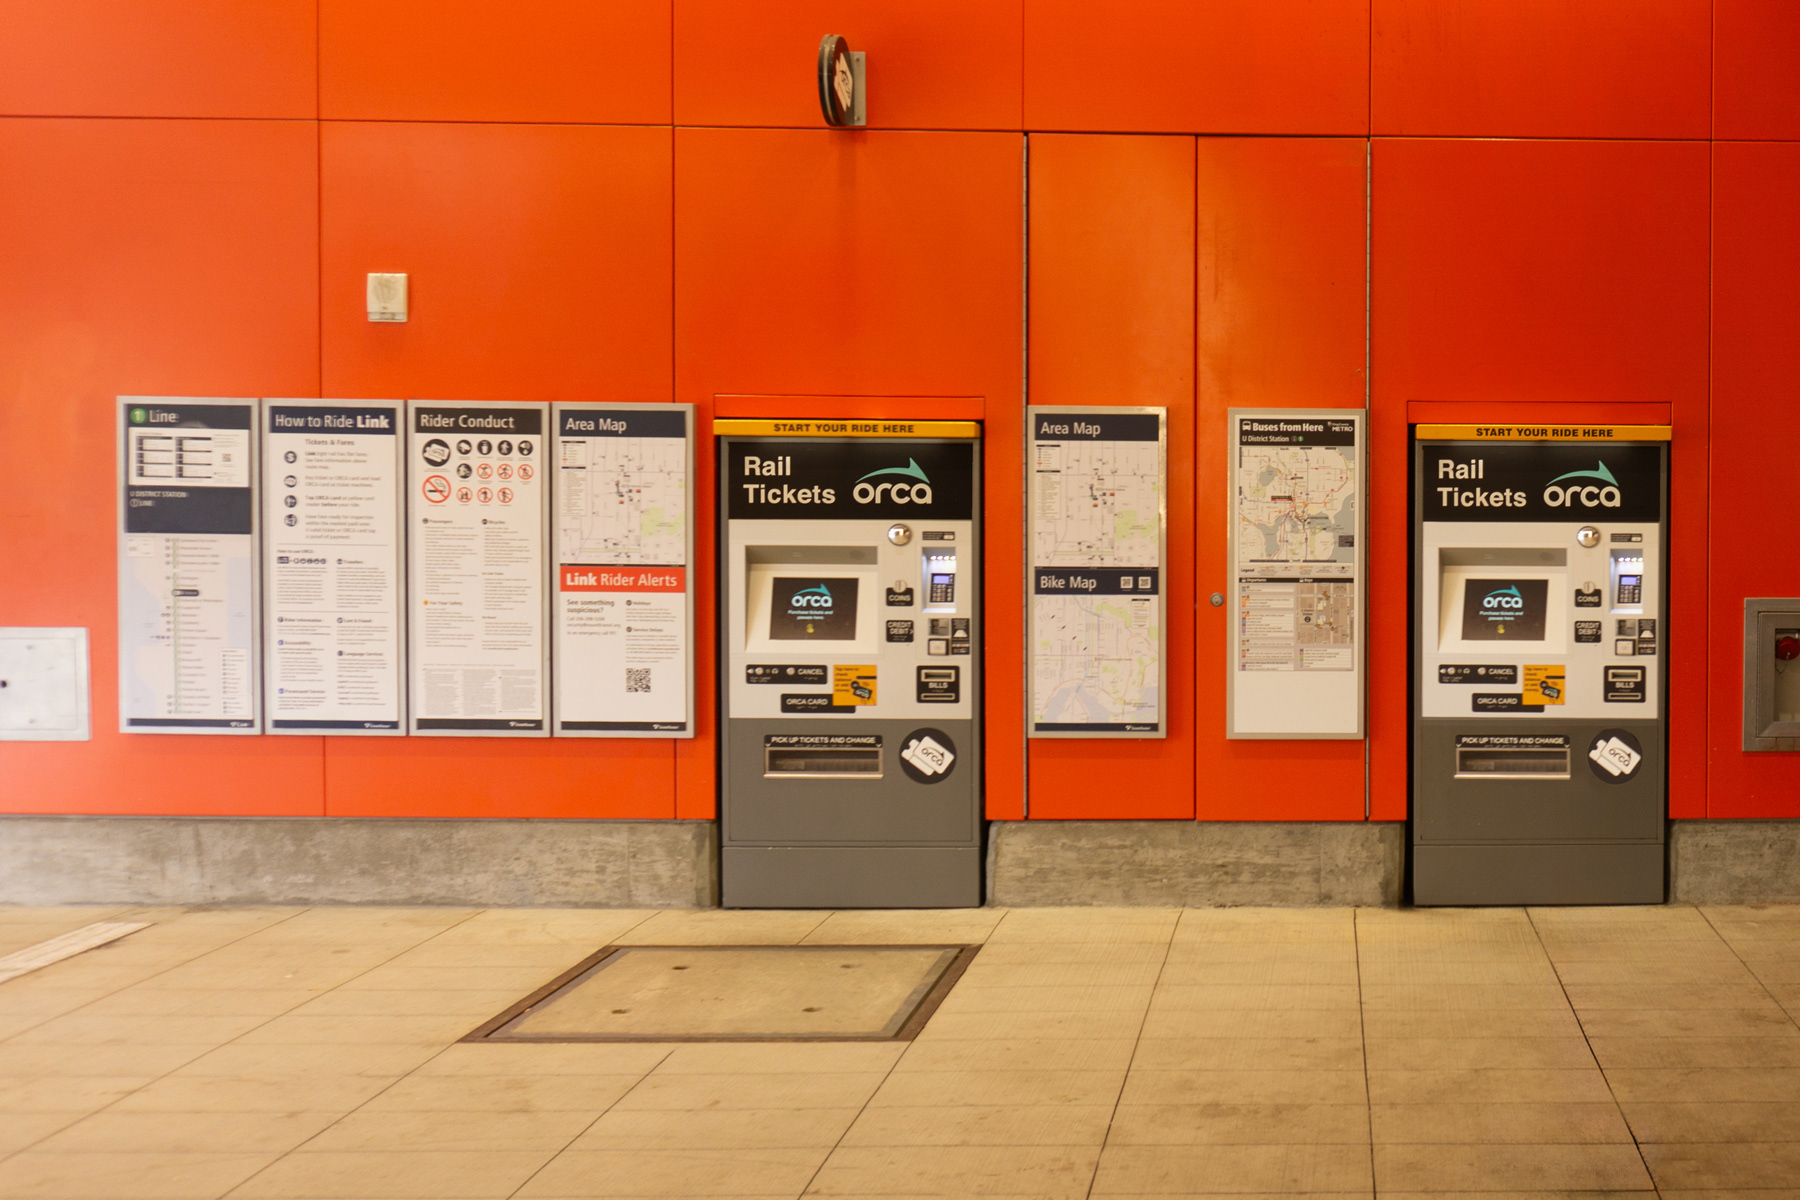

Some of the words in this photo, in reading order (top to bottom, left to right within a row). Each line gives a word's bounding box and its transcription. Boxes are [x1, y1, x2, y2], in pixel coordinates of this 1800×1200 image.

[134, 410, 140, 420] 1
[149, 410, 178, 422] Line
[275, 414, 305, 428] How
[307, 414, 321, 428] to
[324, 414, 353, 428] Ride
[356, 414, 390, 428] Link
[421, 414, 454, 428] Rider
[458, 415, 515, 428] Conduct
[566, 418, 595, 431] Area
[599, 418, 626, 434] Map
[774, 424, 811, 432] START
[815, 424, 847, 432] YOUR
[852, 424, 878, 432] RIDE
[883, 425, 914, 433] HERE
[1040, 422, 1069, 434] Area
[1074, 422, 1100, 438] Map
[1252, 423, 1279, 431] Buses
[1280, 422, 1301, 431] from
[1302, 424, 1324, 432] Here
[1476, 428, 1512, 437] START
[1516, 429, 1548, 437] YOUR
[1552, 429, 1579, 437] RIDE
[1583, 429, 1613, 437] HERE
[745, 456, 790, 476] Rail
[1438, 459, 1484, 479] Rail
[743, 484, 836, 504] Tickets
[853, 483, 932, 504] orca
[1437, 487, 1527, 507] Tickets
[1543, 485, 1621, 508] orca
[566, 573, 597, 585] Link
[600, 573, 635, 586] Rider
[638, 574, 677, 586] Alerts
[1040, 576, 1065, 588] Bike
[1070, 576, 1096, 591] Map
[791, 595, 832, 608] orca
[1483, 596, 1522, 608] orca
[921, 747, 943, 766] orca
[1608, 748, 1630, 767] orca
